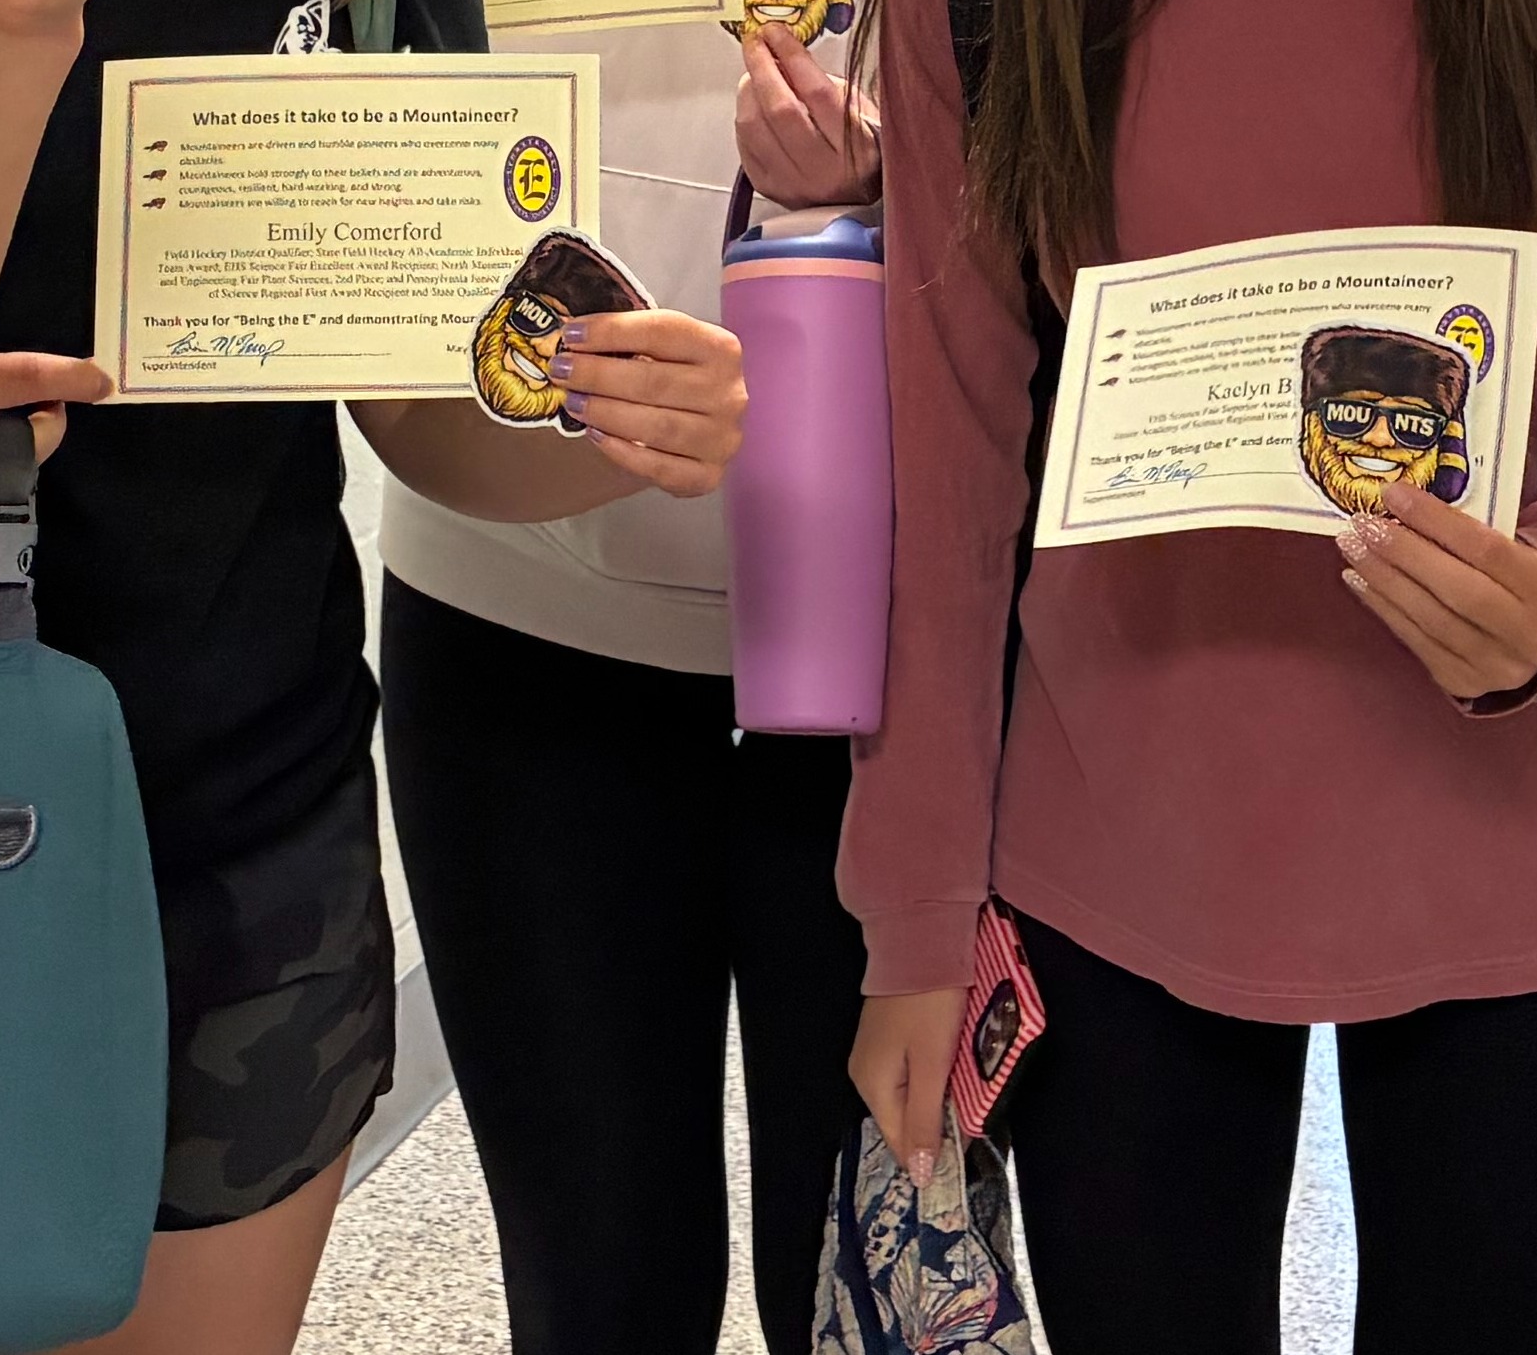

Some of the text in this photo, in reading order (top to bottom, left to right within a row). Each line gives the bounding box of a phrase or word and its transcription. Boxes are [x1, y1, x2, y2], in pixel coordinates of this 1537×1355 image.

[193, 108, 518, 125] What does it take to be a Mountaineer?
[519, 159, 546, 200] E
[267, 222, 442, 245] Emily Comerford
[1150, 275, 1453, 314] What does it take to be a Mountaineer?
[144, 317, 182, 327] Thank
[186, 318, 208, 328] you
[213, 315, 229, 325] for
[233, 315, 275, 327] "Being
[279, 315, 298, 325] the
[303, 314, 316, 324] E"
[319, 314, 343, 324] and
[347, 314, 438, 326] demonstrating
[515, 298, 553, 329] MOU
[1327, 403, 1435, 436] MOU NTS
[1091, 456, 1121, 466] Thank
[1125, 451, 1144, 464] you
[1147, 448, 1162, 458] for
[1204, 441, 1222, 449] the
[1241, 436, 1263, 446] and
